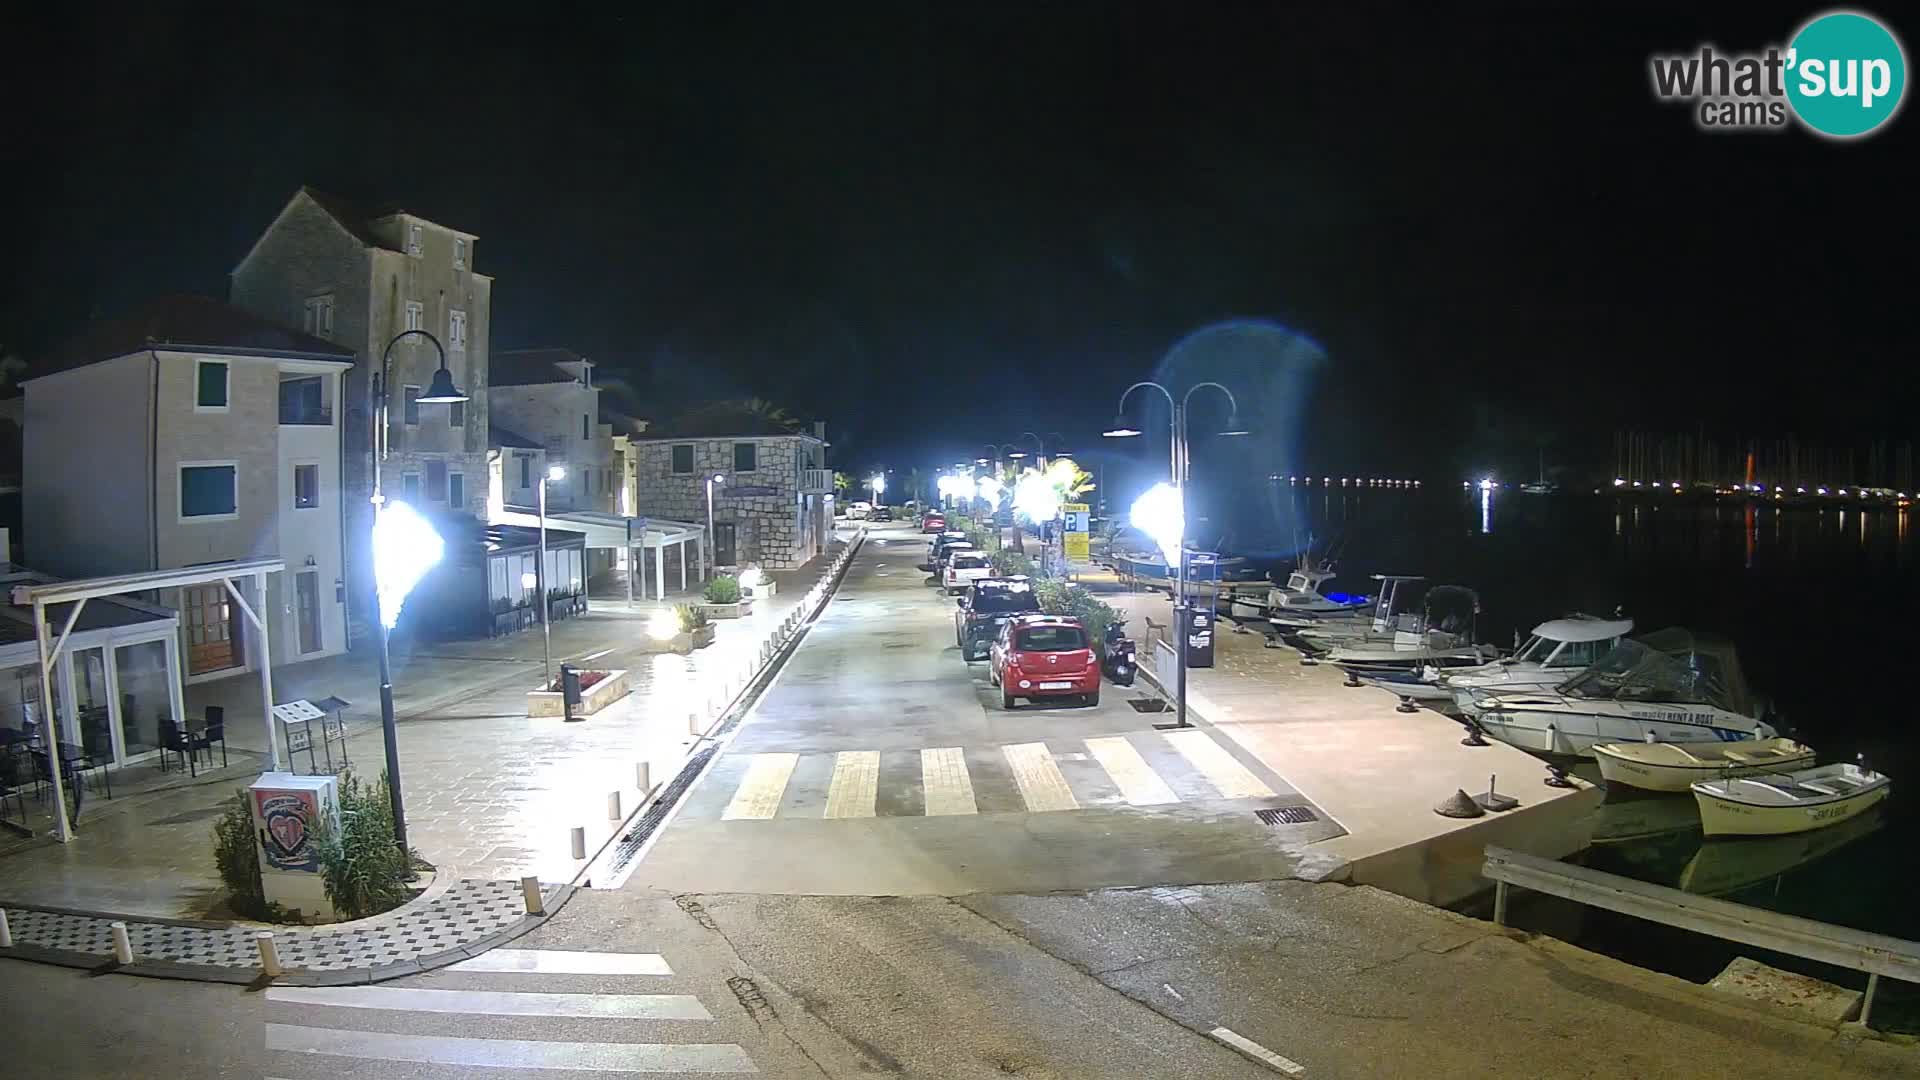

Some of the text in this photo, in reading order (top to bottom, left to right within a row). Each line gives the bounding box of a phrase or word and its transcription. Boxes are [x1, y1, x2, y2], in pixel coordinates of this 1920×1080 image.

[1065, 514, 1076, 530] P
[1667, 711, 1688, 723] RENT
[1695, 712, 1714, 725] BOAT
